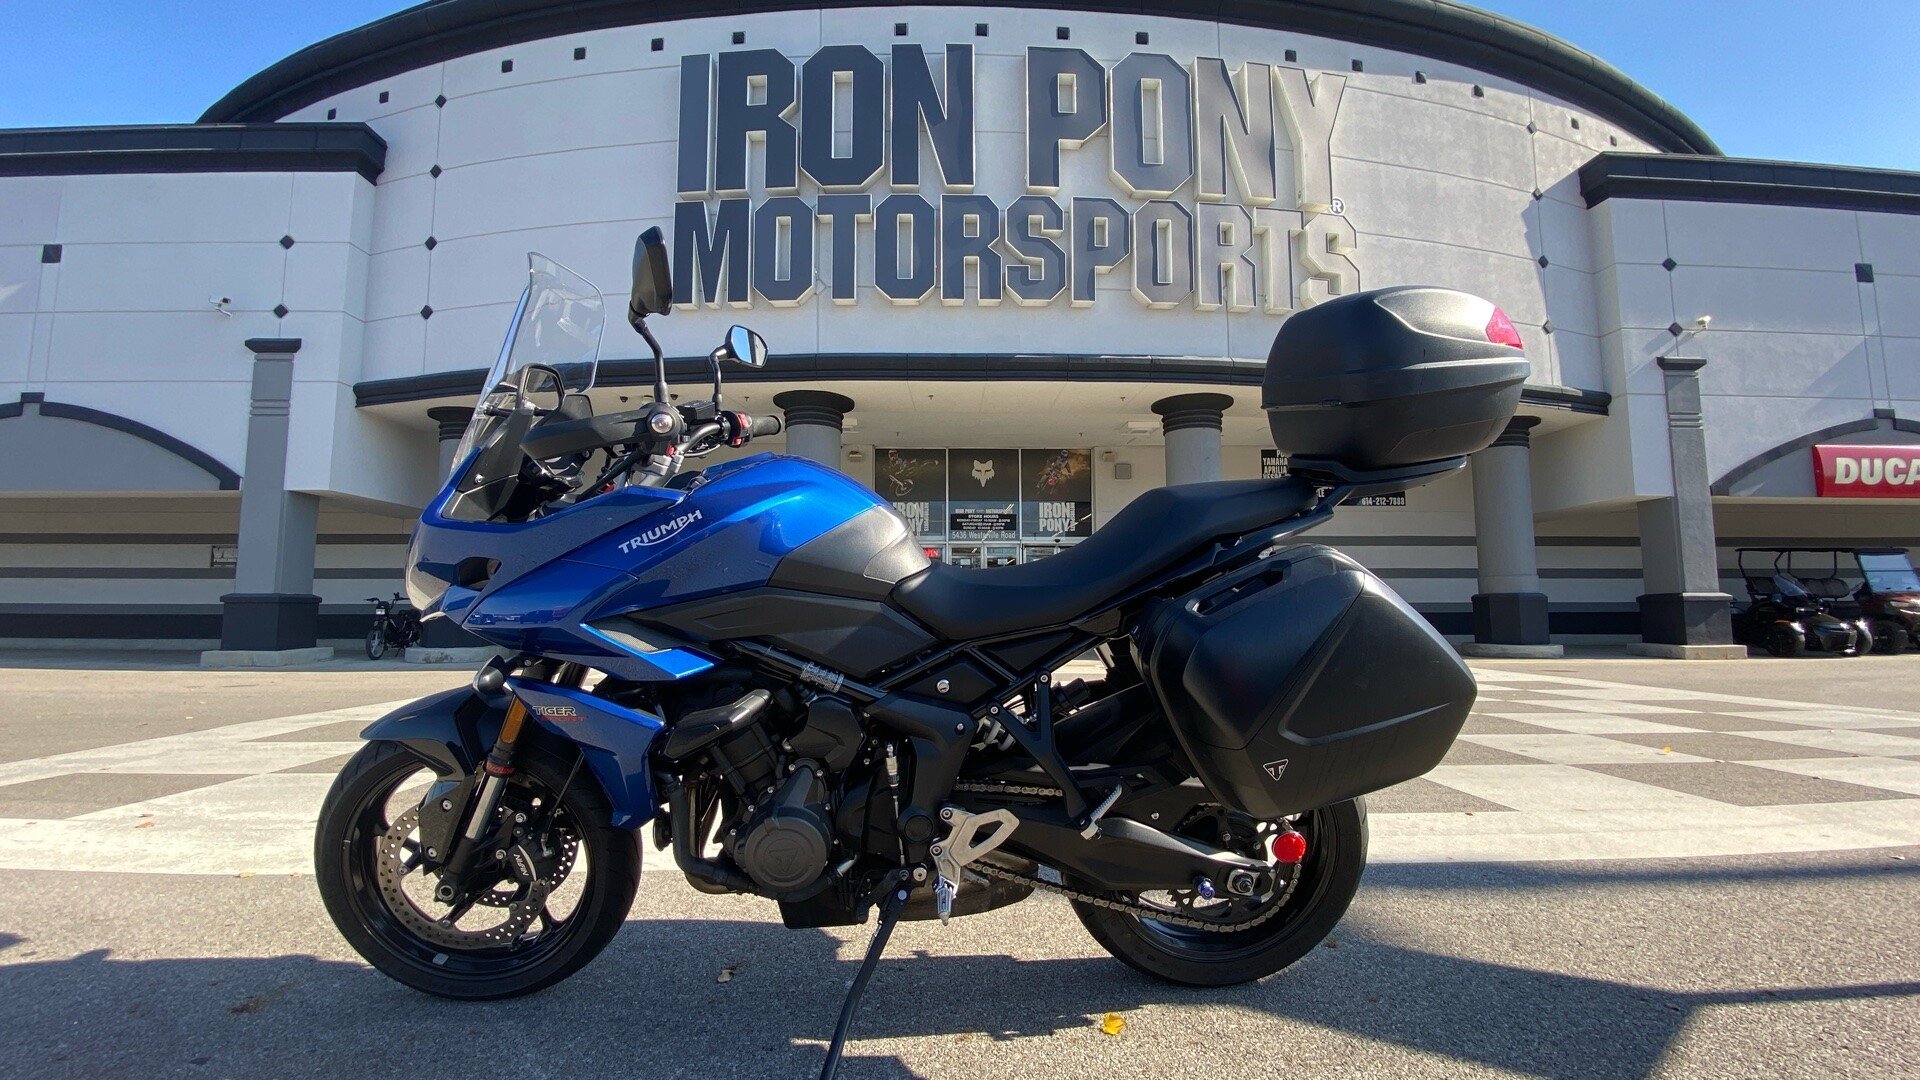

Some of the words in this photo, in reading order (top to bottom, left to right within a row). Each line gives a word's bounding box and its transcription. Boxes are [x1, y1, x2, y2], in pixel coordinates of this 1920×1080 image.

[677, 43, 976, 198] IRON
[1025, 46, 1348, 212] PONY
[672, 194, 1361, 313] MOTORSPORTS
[1262, 457, 1288, 466] YAMAHA
[1264, 465, 1288, 474] APRILIA
[1039, 502, 1070, 518] IRON
[618, 509, 703, 554] TRIUMPH
[1039, 518, 1070, 531] PONY
[952, 531, 967, 539] 5436
[1000, 531, 1016, 539] Road
[532, 705, 577, 717] TIGER
[513, 853, 529, 876] NISSIN
